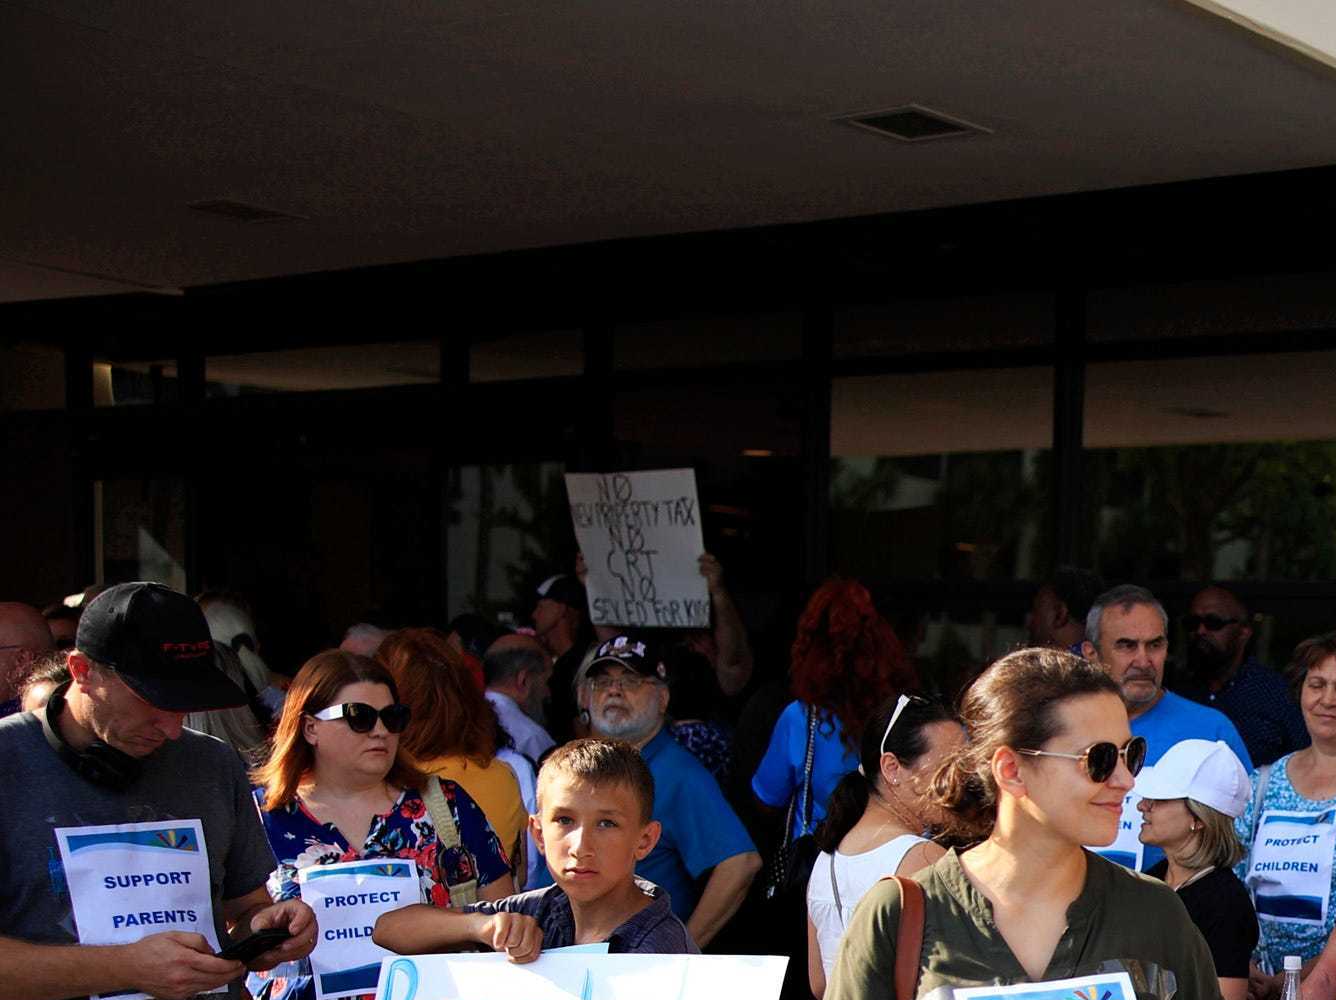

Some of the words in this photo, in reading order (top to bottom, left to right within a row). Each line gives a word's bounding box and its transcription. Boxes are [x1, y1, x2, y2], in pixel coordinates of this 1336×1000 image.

[666, 496, 696, 527] TAX
[607, 550, 658, 579] CRT
[1254, 861, 1319, 873] CHILDREN
[104, 871, 192, 889] SUPPORT
[324, 891, 401, 908] PROTECT
[112, 910, 197, 928] PARENTS
